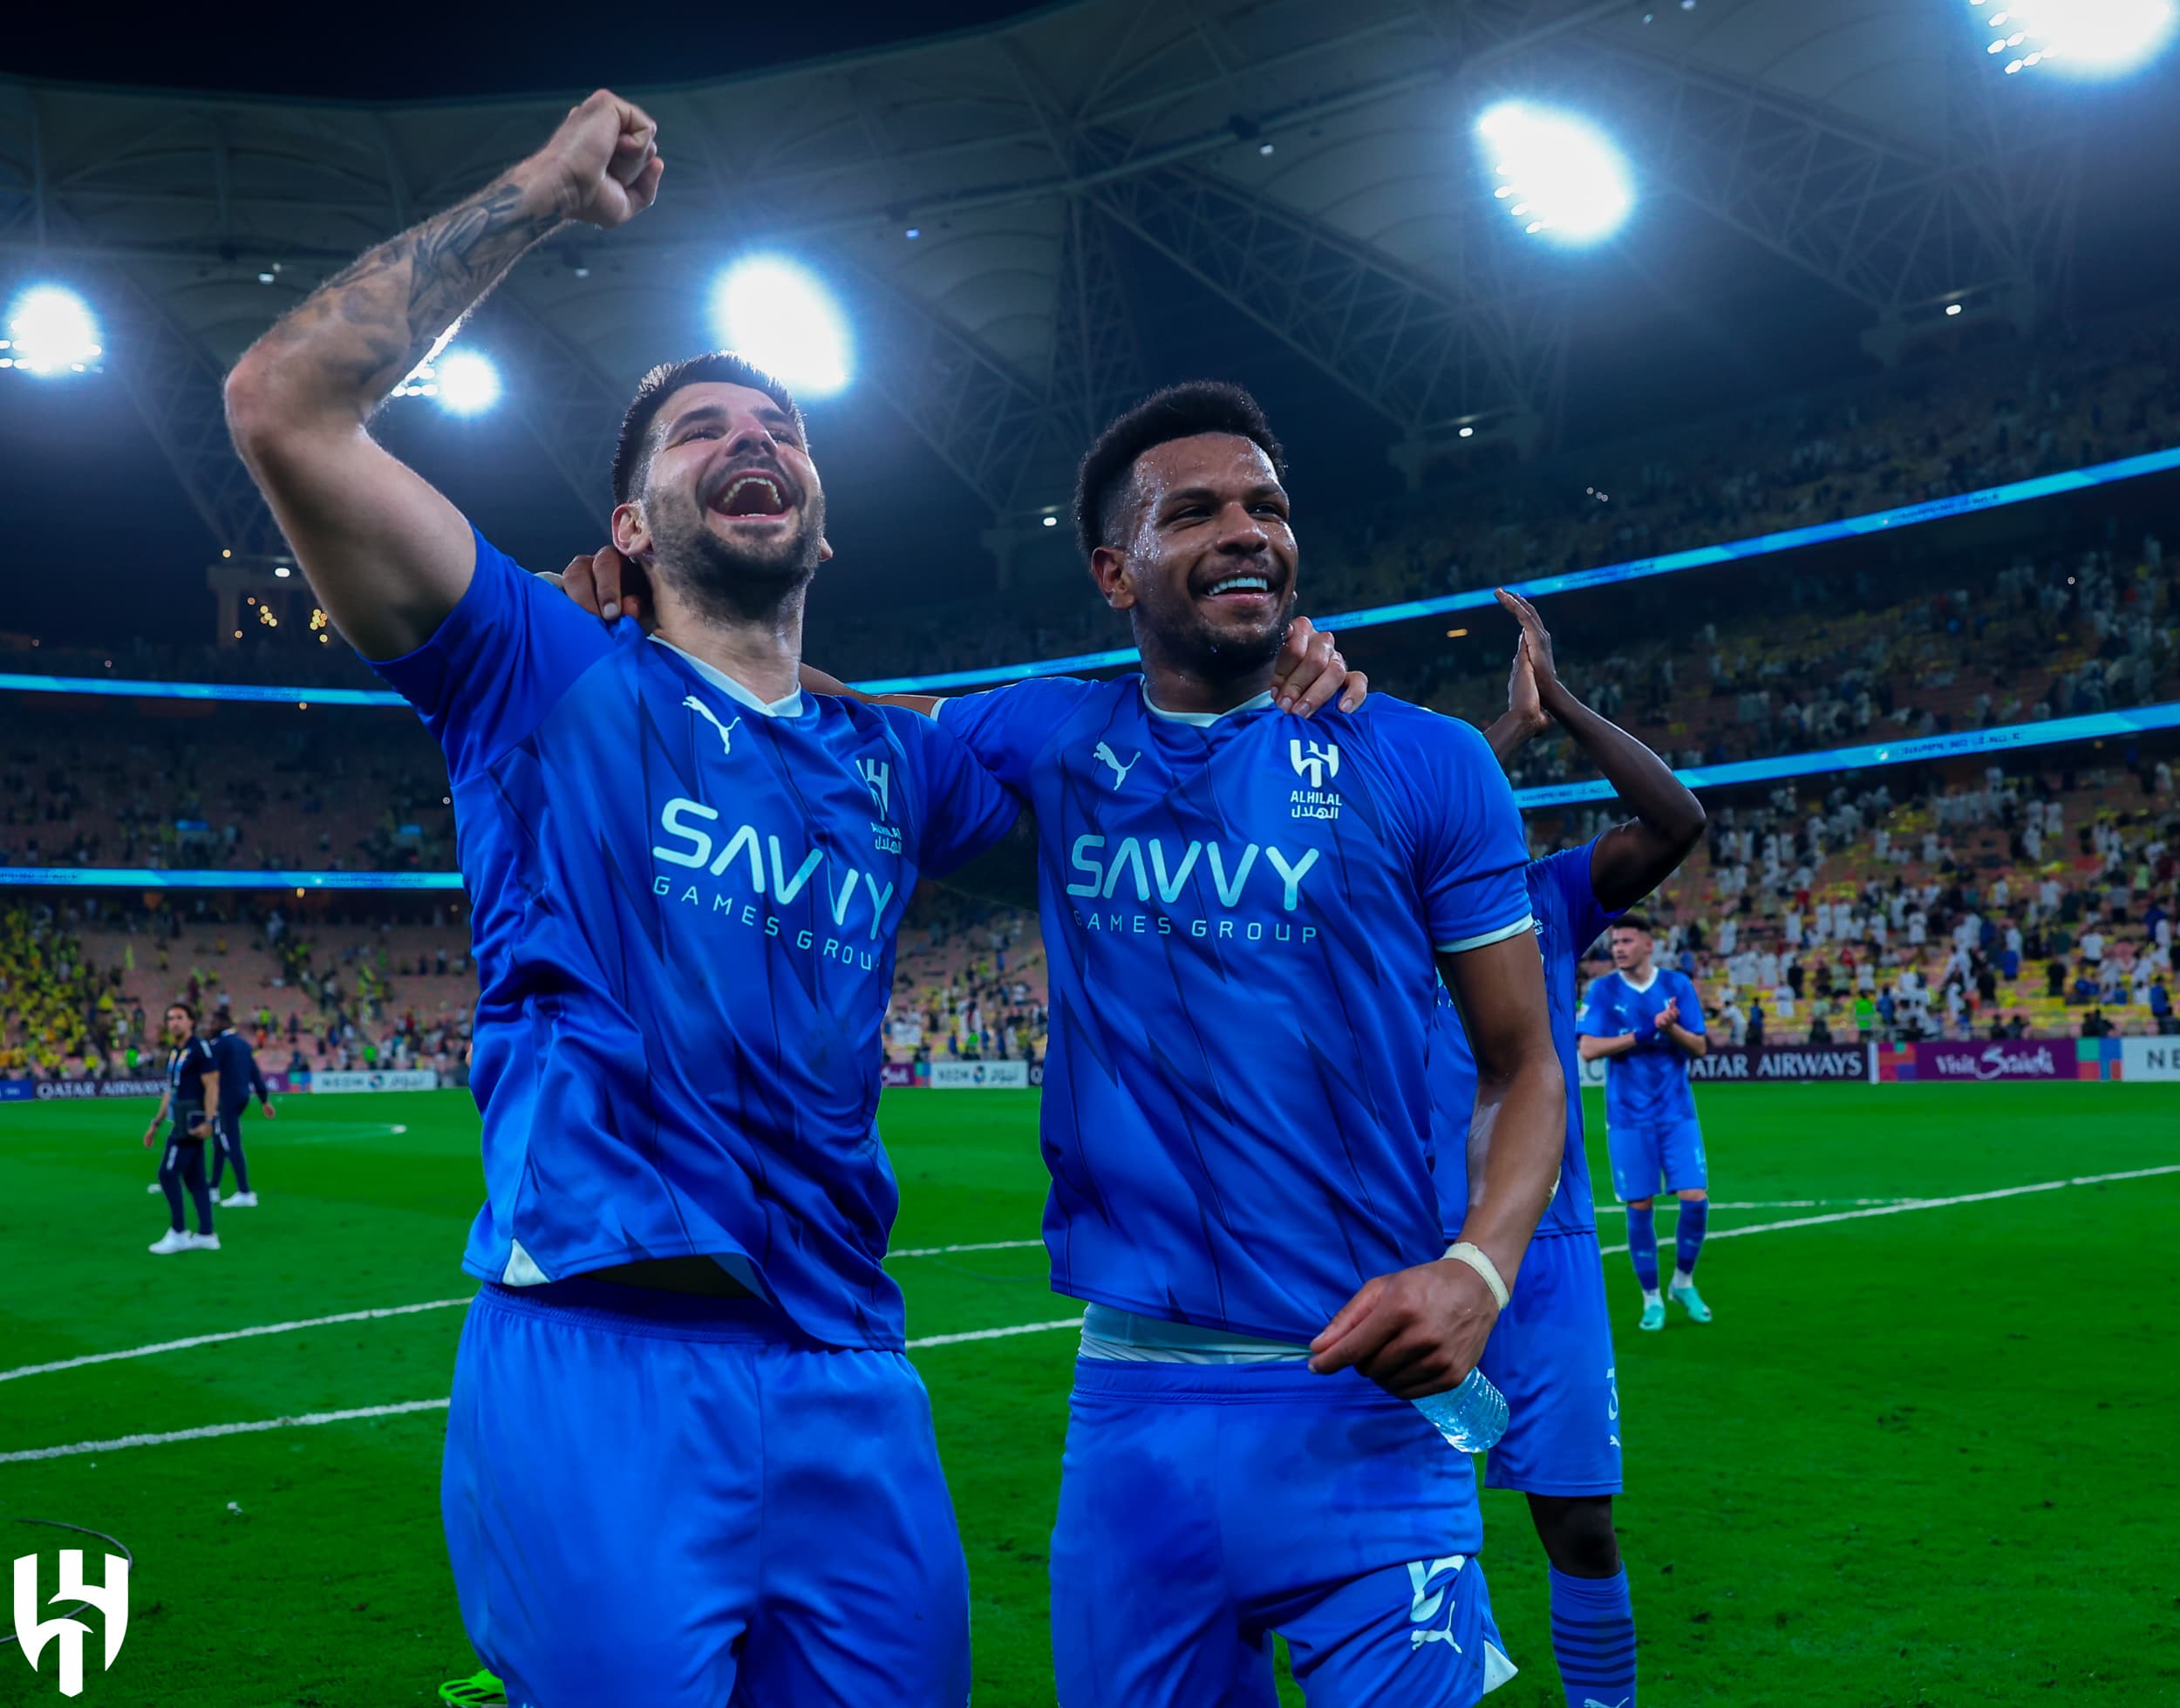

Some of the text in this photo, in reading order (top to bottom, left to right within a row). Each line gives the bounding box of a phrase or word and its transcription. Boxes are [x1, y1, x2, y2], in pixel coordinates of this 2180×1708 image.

[1291, 790, 1343, 806] ALHILAL
[653, 798, 894, 941] SAVVY
[1066, 834, 1320, 911] SAVVY
[654, 875, 881, 971] GAMES GROU
[1073, 909, 1318, 944] GAMES GROUP
[1686, 1051, 1863, 1079] ATAR AIRWAYS
[37, 1081, 95, 1099] QATAR
